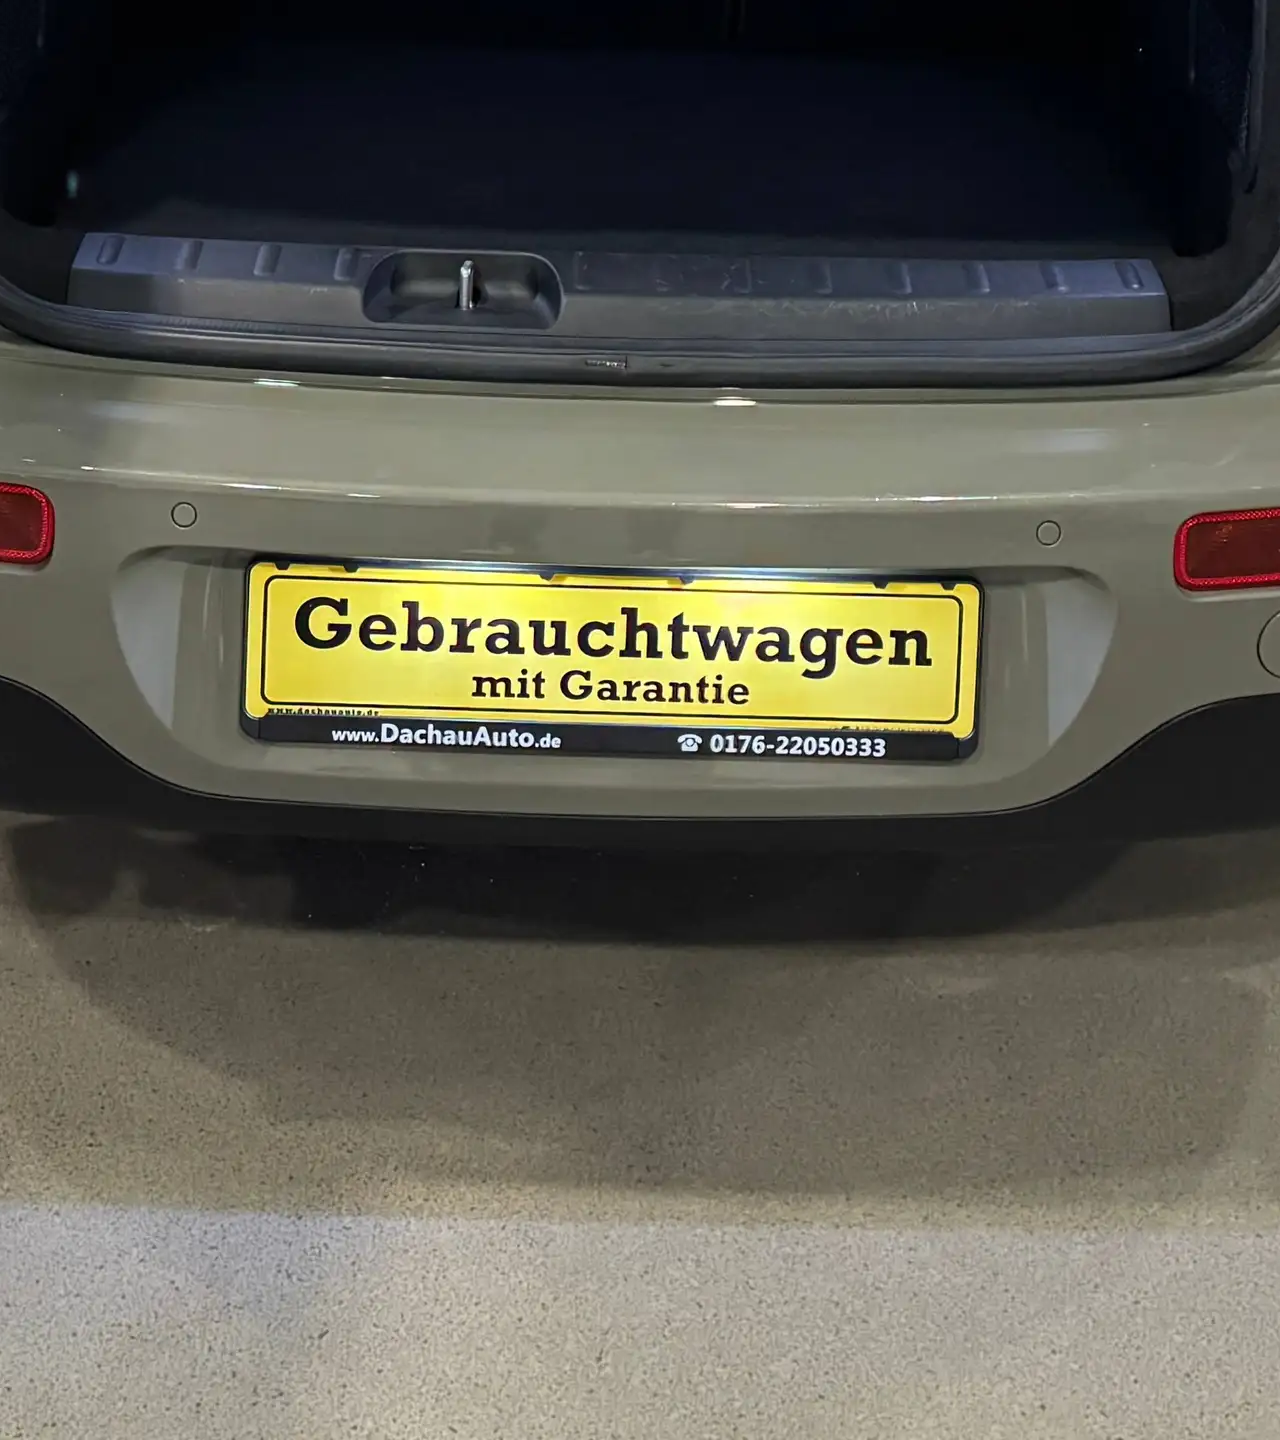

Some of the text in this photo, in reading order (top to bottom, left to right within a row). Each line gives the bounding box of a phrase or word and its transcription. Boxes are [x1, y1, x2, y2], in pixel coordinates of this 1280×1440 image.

[294, 596, 932, 679] Gebrauchtwagen
[471, 669, 750, 706] mit Garantie
[332, 723, 562, 748] www.DachauAuto.de
[710, 734, 886, 757] 0176-22050333
